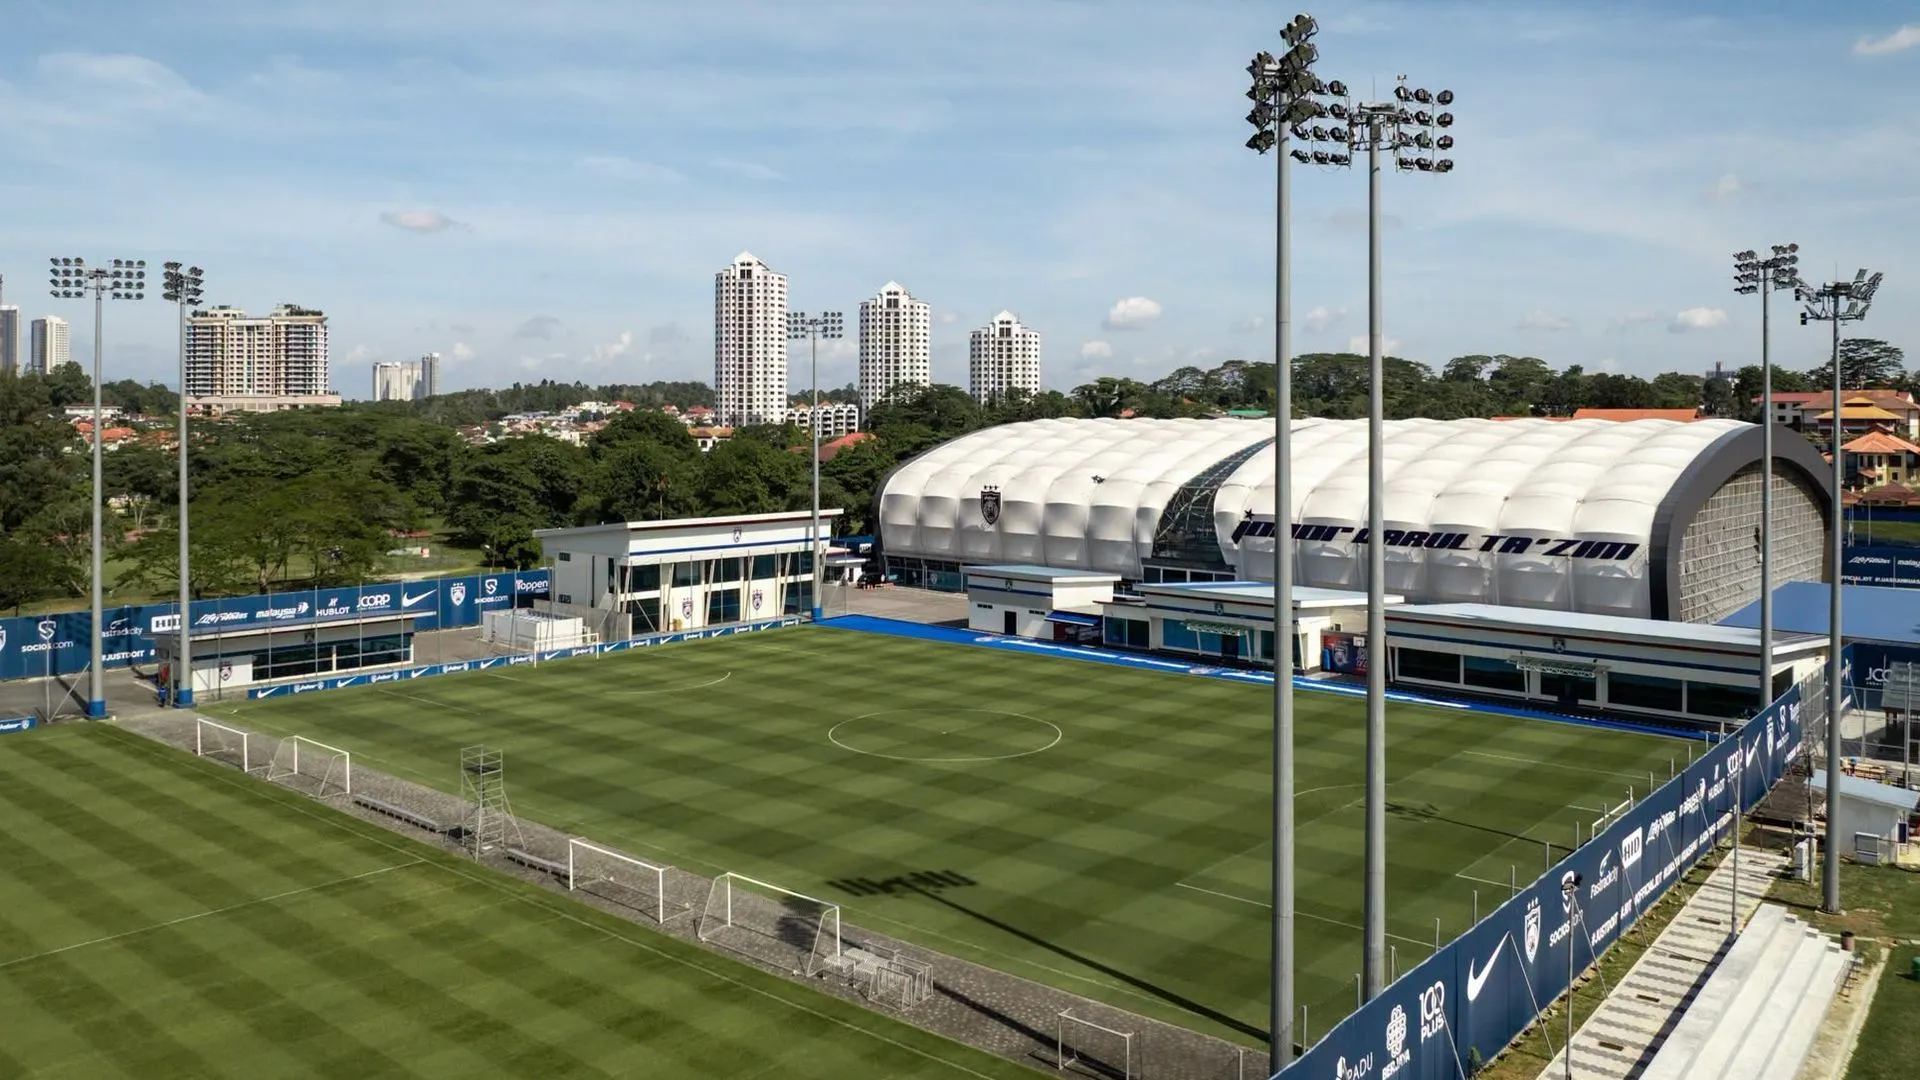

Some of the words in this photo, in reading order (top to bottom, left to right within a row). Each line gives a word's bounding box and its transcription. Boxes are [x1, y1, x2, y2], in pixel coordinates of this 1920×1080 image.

[1231, 520, 1354, 545] JOOR
[1479, 534, 1640, 561] TA'ZIM
[515, 579, 549, 592] Toppen
[316, 606, 350, 617] HUBLOT
[101, 626, 143, 638] astrackcity
[1419, 980, 1445, 1026] 100
[1420, 1012, 1445, 1044] PLUS
[1347, 1051, 1374, 1080] PADU
[1382, 1049, 1410, 1080] BERJAYA
